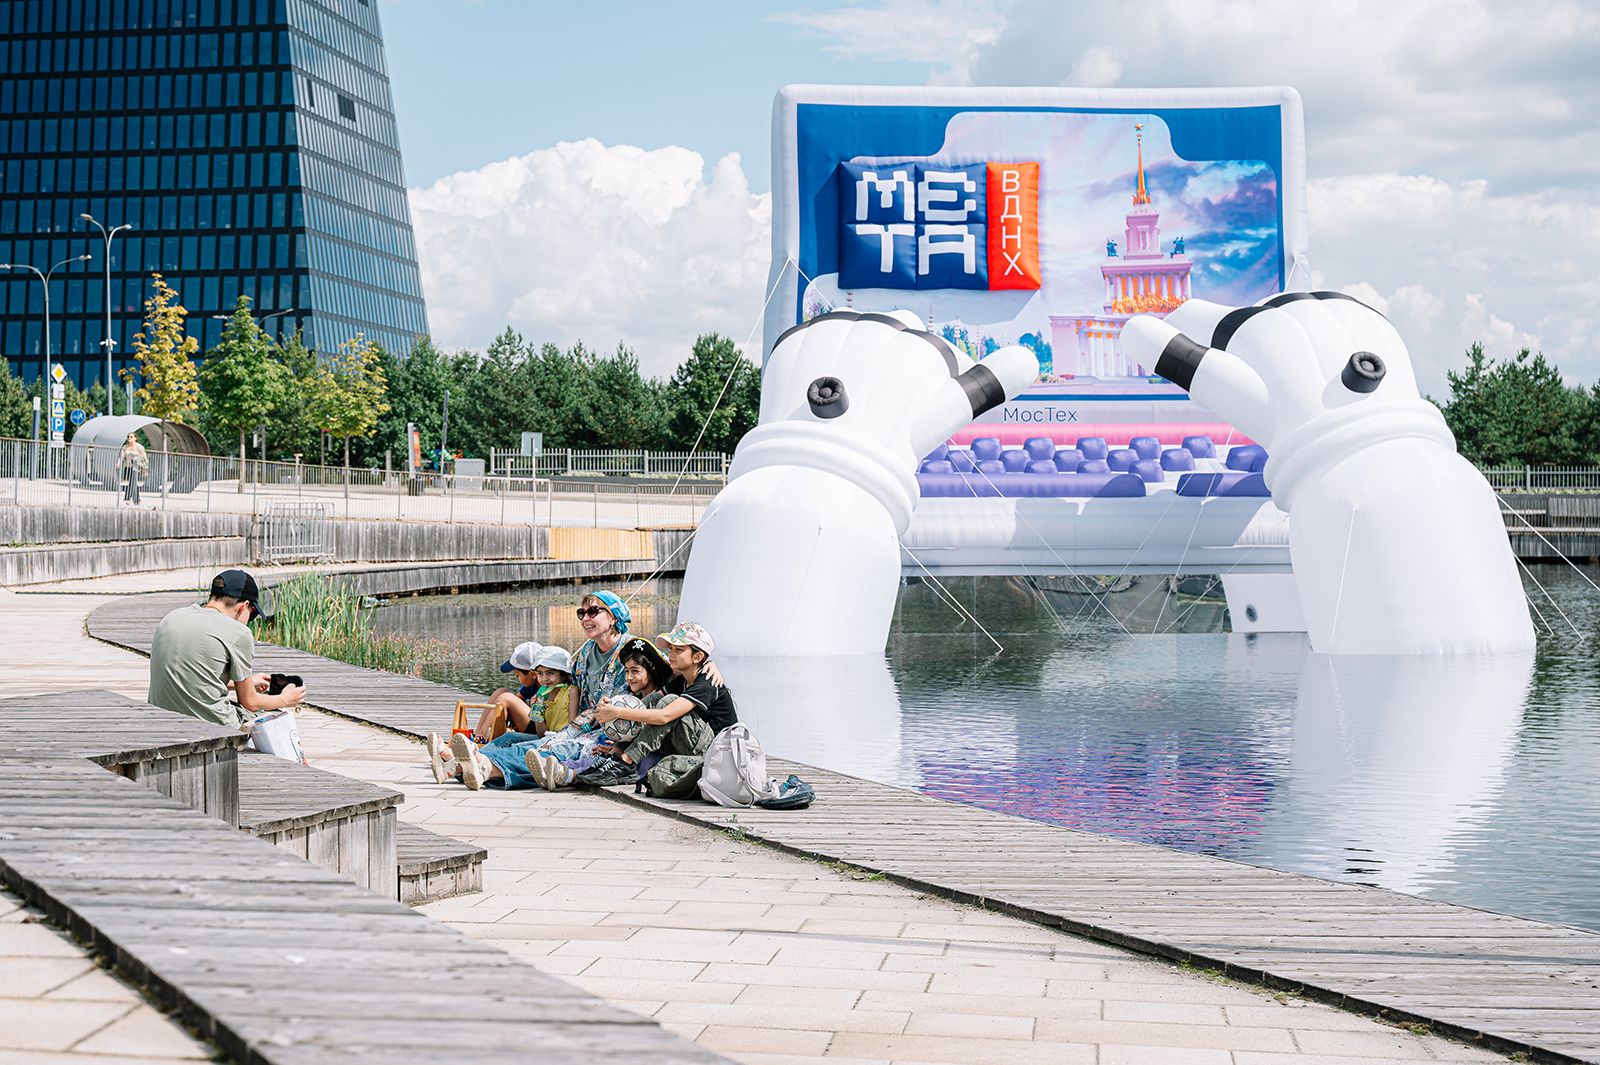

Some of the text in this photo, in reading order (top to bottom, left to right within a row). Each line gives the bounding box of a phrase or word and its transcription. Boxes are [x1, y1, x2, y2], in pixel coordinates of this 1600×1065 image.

[1000, 169, 1024, 277] ВДНХ
[1003, 406, 1078, 423] МосТех
[55, 418, 63, 431] P
